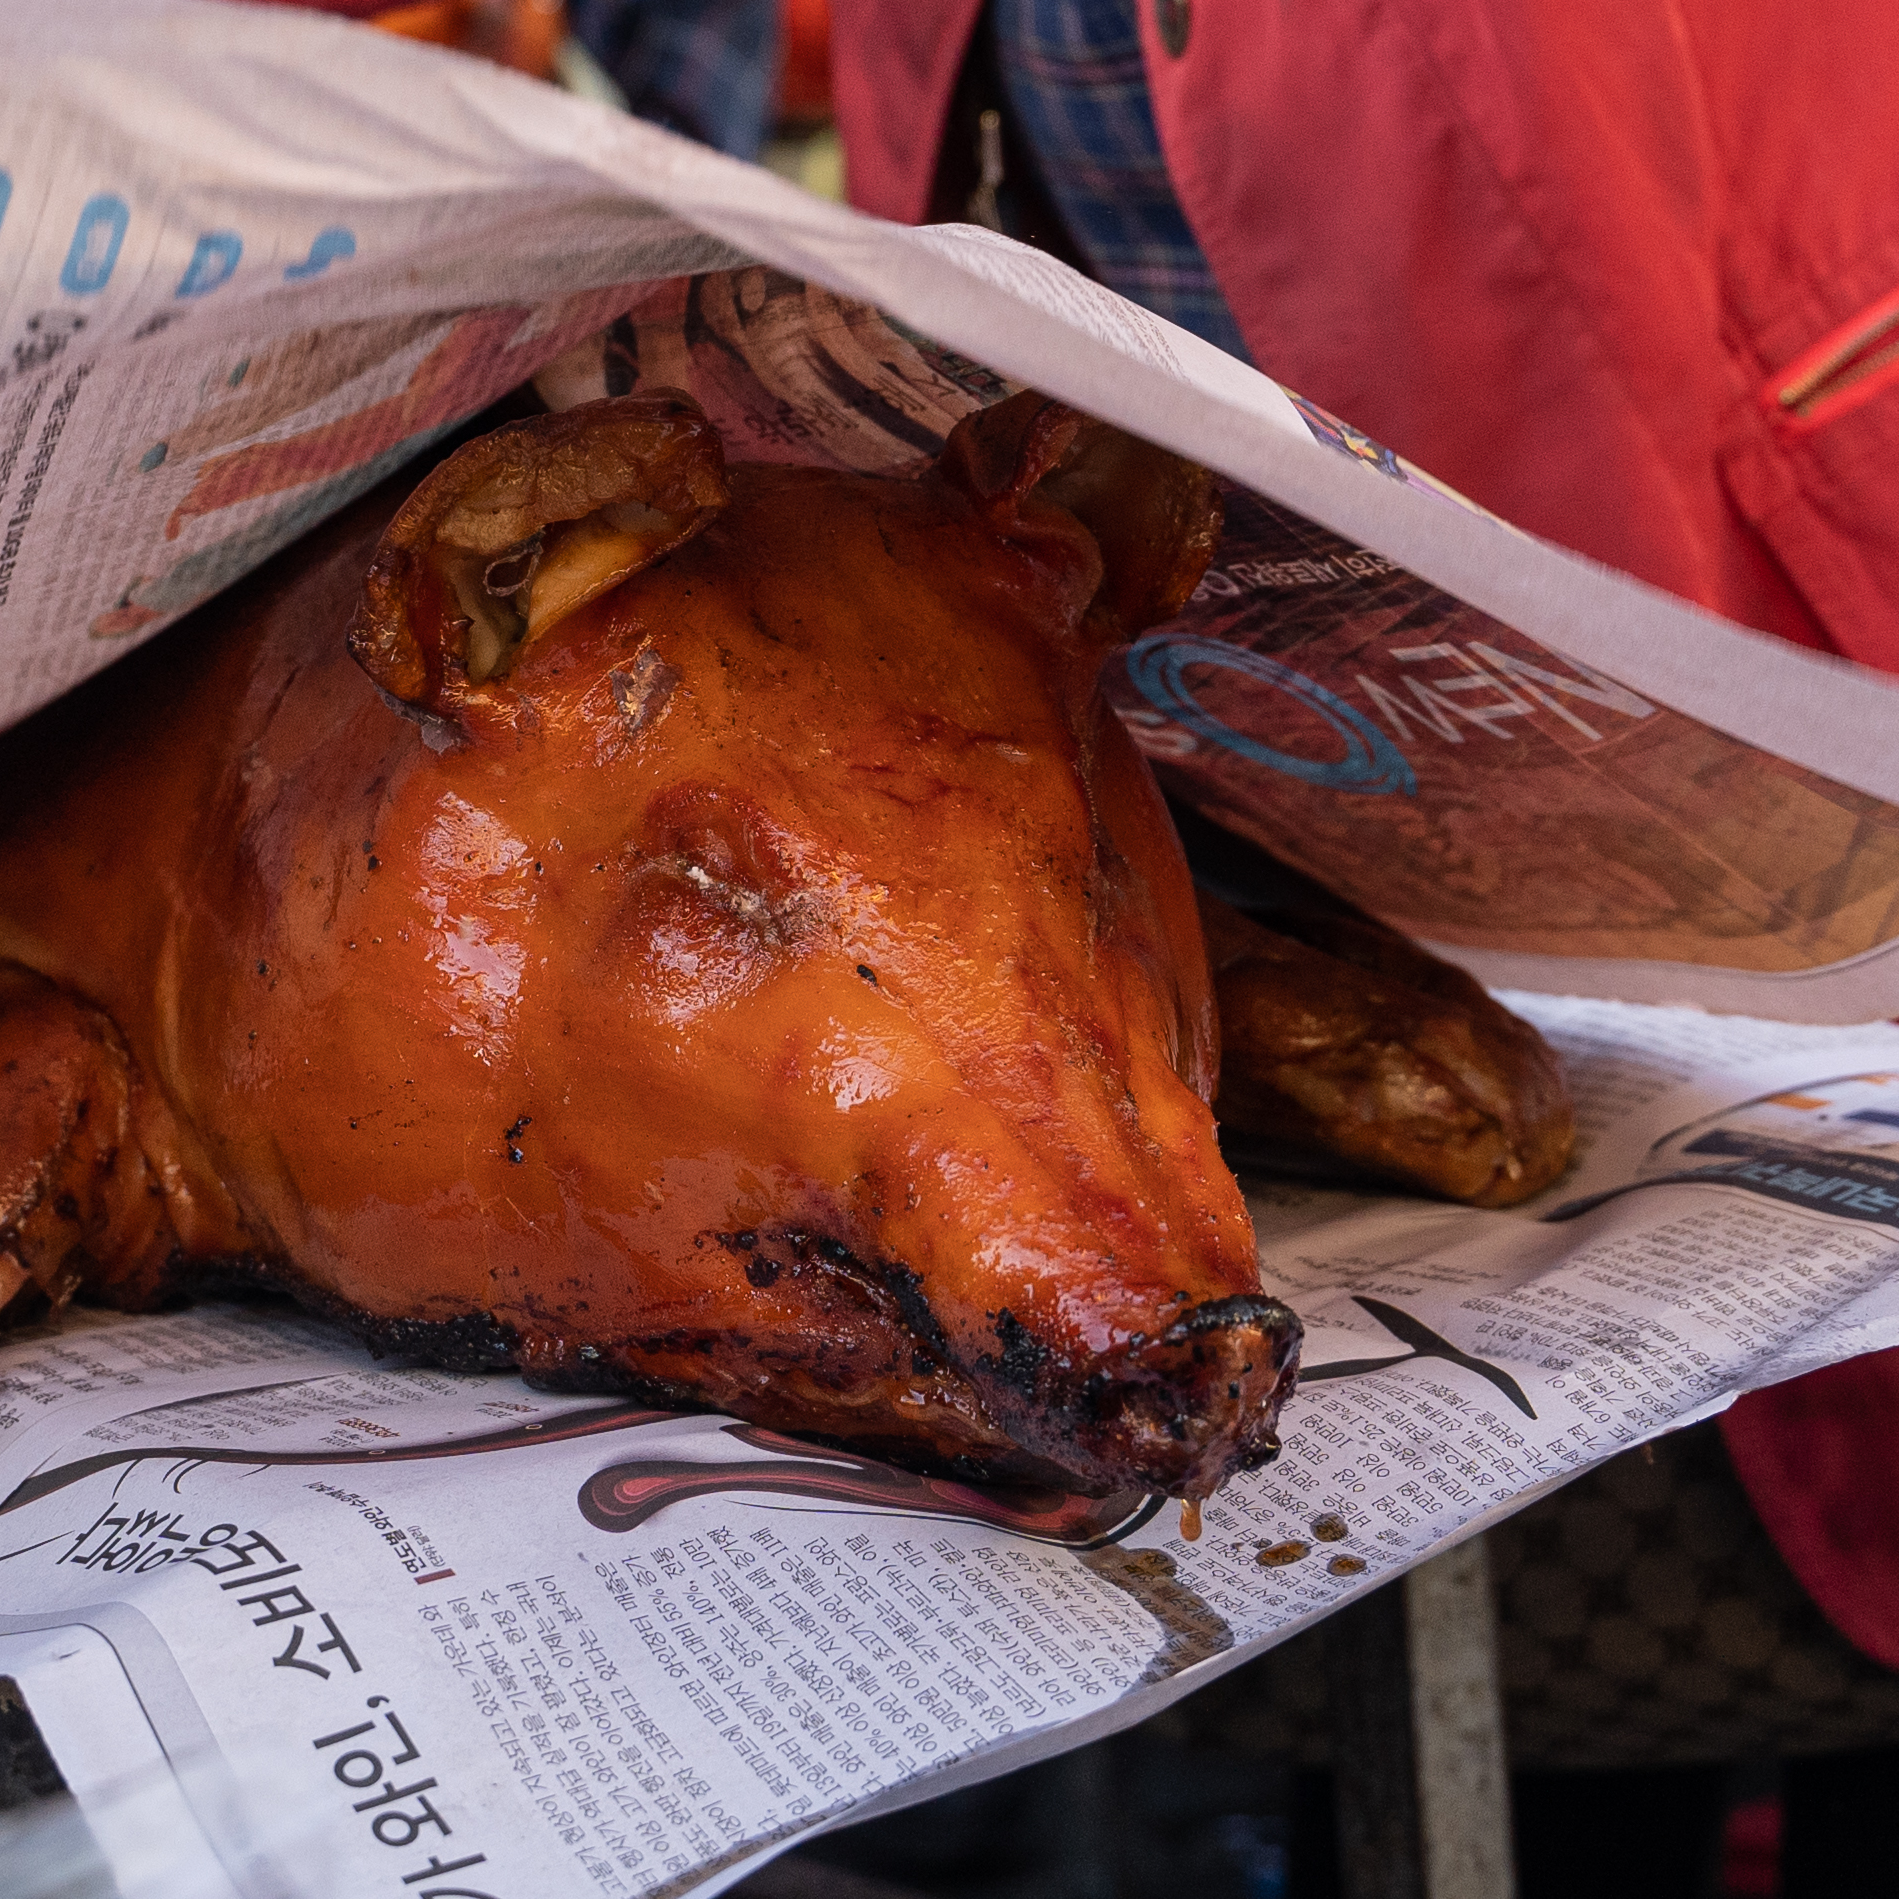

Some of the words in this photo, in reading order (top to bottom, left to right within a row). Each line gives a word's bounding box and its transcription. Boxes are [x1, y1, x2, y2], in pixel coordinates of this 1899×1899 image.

[1354, 640, 1658, 745] NEW
[1545, 1367, 1565, 1388] 이
[1565, 1390, 1611, 1423] 6개월
[1300, 1414, 1353, 1448] 10만원
[1382, 1409, 1433, 1444] 준비한
[1475, 1411, 1524, 1448] 완판을
[1567, 1423, 1604, 1450] 가격
[1279, 1433, 1329, 1465] 5만원
[1356, 1454, 1390, 1477] 이상
[1380, 1437, 1426, 1470] 이상은
[1429, 1440, 1493, 1486] 상품으로
[1461, 1431, 1528, 1483] 그랑크뤼,
[1274, 1460, 1320, 1491] 3만원
[1332, 1469, 1366, 1492] 이상
[1423, 1468, 1477, 1506] 10만원
[1323, 1493, 1371, 1527] 비중은
[1372, 1495, 1423, 1527] 3만원
[1396, 1480, 1443, 1514] 5만원
[359, 1508, 393, 1529] 와인
[382, 1525, 426, 1573] 연도별
[679, 1538, 717, 1569] 10만
[707, 1526, 755, 1570] 증가했
[750, 1527, 789, 1557] 11배
[804, 1537, 841, 1565] 와인
[844, 1534, 876, 1561] 이탈
[893, 1540, 927, 1568] 미국
[1163, 1539, 1200, 1560] 판매
[1375, 1529, 1410, 1547] 매출
[621, 1550, 657, 1587] 증가
[650, 1547, 685, 1579] 전통
[746, 1567, 777, 1589] 4배
[781, 1555, 825, 1597] 매출은
[972, 1547, 1020, 1583] 라인업
[1006, 1551, 1041, 1573] 신장
[481, 1589, 500, 1605] 수
[506, 1581, 539, 1614] 국내
[535, 1575, 583, 1623] 분석이
[595, 1562, 637, 1611] 매출은
[835, 1562, 881, 1604] 프랑스
[928, 1568, 979, 1617] 투스칸),
[1037, 1577, 1072, 1603] 높은
[1197, 1558, 1287, 1606] 행사가격으로
[190, 1531, 362, 1679] 소비도
[418, 1605, 443, 1621] 와
[447, 1597, 479, 1630] 특히
[649, 1589, 682, 1622] 55%
[683, 1580, 724, 1624] 140%,
[712, 1569, 789, 1649] 가격대별로는
[817, 1593, 855, 1623] 와인
[1014, 1587, 1078, 1635] 프리미엄
[491, 1610, 527, 1645] 한정
[671, 1622, 707, 1655] 대비
[769, 1591, 840, 1656] 지난해보다
[875, 1600, 940, 1664] 국가별로는
[1064, 1604, 1111, 1640] 나라가
[431, 1624, 476, 1677] 가운데
[537, 1617, 573, 1668] 이제는
[579, 1629, 621, 1681] 있다는
[630, 1615, 689, 1678] 와인장터
[720, 1624, 763, 1667] 양주는
[846, 1621, 896, 1661] 초고가
[975, 1618, 1045, 1676] 와인(슈퍼
[1071, 1639, 1095, 1652] 등
[476, 1634, 530, 1709] 기록했다.
[521, 1649, 566, 1709] 팔렸고,
[697, 1652, 734, 1684] 전년
[760, 1665, 796, 1702] 30%,
[784, 1645, 844, 1703] 신장했다.
[832, 1653, 880, 1697] 매출이
[886, 1660, 919, 1689] 이상
[938, 1662, 989, 1709] 늘었다.
[1091, 1658, 1140, 1690] 와인)
[472, 1680, 503, 1716] 있는
[569, 1672, 623, 1745] 이어갔다.
[679, 1679, 728, 1726] 따르면
[724, 1681, 787, 1739] 19일까지
[873, 1692, 912, 1724] 와인
[914, 1686, 967, 1732] 50만원
[1038, 1679, 1076, 1706] 리아
[555, 1713, 581, 1732] 잘
[611, 1686, 683, 1764] 고급화되고
[789, 1700, 834, 1744] 매출은
[835, 1702, 868, 1731] 이상
[979, 1706, 1013, 1741] 이상
[522, 1714, 566, 1764] 실적을
[866, 1729, 899, 1759] 40%
[903, 1723, 937, 1752] 이상
[317, 1697, 451, 1846] 와인,
[491, 1720, 545, 1792] 지속되고
[569, 1735, 618, 1783] 와인이
[618, 1746, 664, 1793] 행진을
[720, 1724, 795, 1797] 롯데마트에
[776, 1737, 841, 1795] 13일부터
[827, 1740, 866, 1773] 와인
[556, 1769, 601, 1818] 역대급
[673, 1767, 711, 1800] 점차
[536, 1795, 585, 1845] 현상이
[608, 1786, 647, 1818] 고가
[654, 1793, 692, 1825] 완판
[594, 1820, 643, 1868] 행사가
[636, 1821, 669, 1852] 이상
[575, 1847, 627, 1894] 고물가
